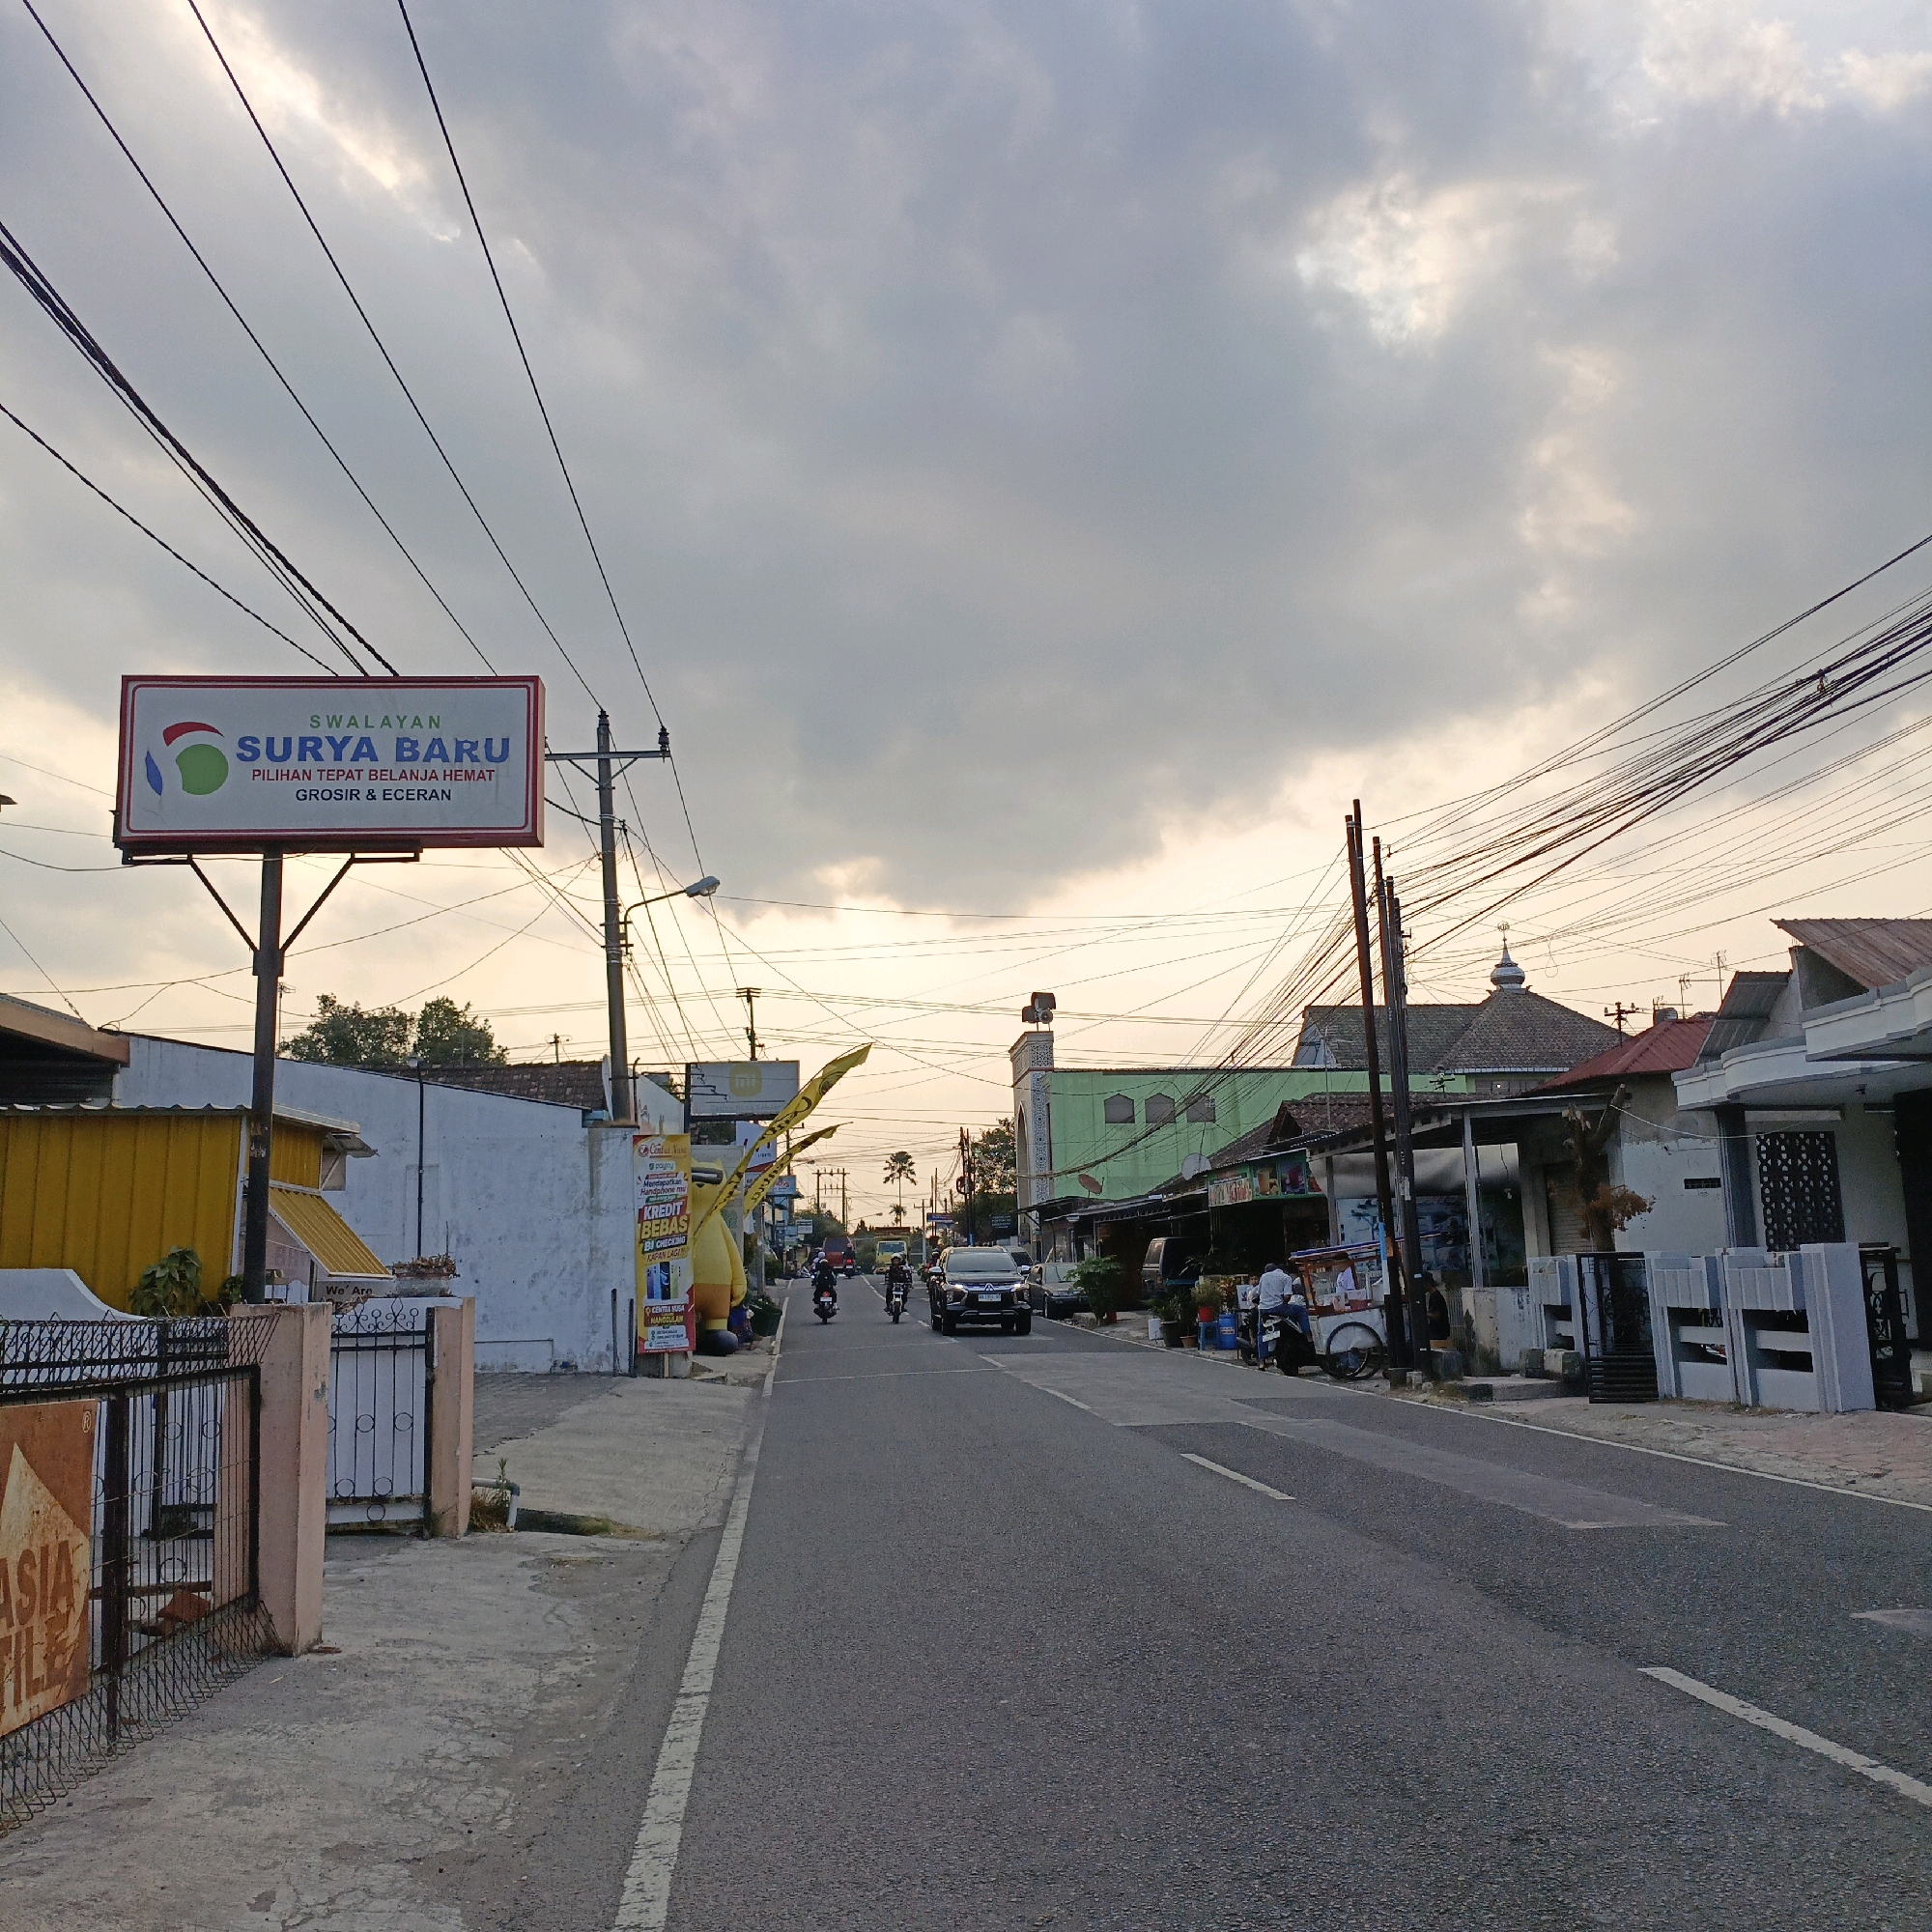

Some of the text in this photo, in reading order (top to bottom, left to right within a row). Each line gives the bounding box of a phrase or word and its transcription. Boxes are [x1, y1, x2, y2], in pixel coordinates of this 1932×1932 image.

[310, 715, 440, 729] SWALAYAN
[236, 735, 510, 763] SURYA BARU
[252, 769, 496, 781] PILIHAN TEPAT BELANJA HEMAT
[296, 788, 451, 801] GROSIR & ECERAN
[642, 1178, 682, 1188] Mendapatkan
[640, 1186, 675, 1196] Handphone
[643, 1201, 684, 1221] KREDIT
[641, 1215, 688, 1239] BEBAS
[352, 1286, 373, 1295] Are
[652, 1305, 670, 1314] CENTRA
